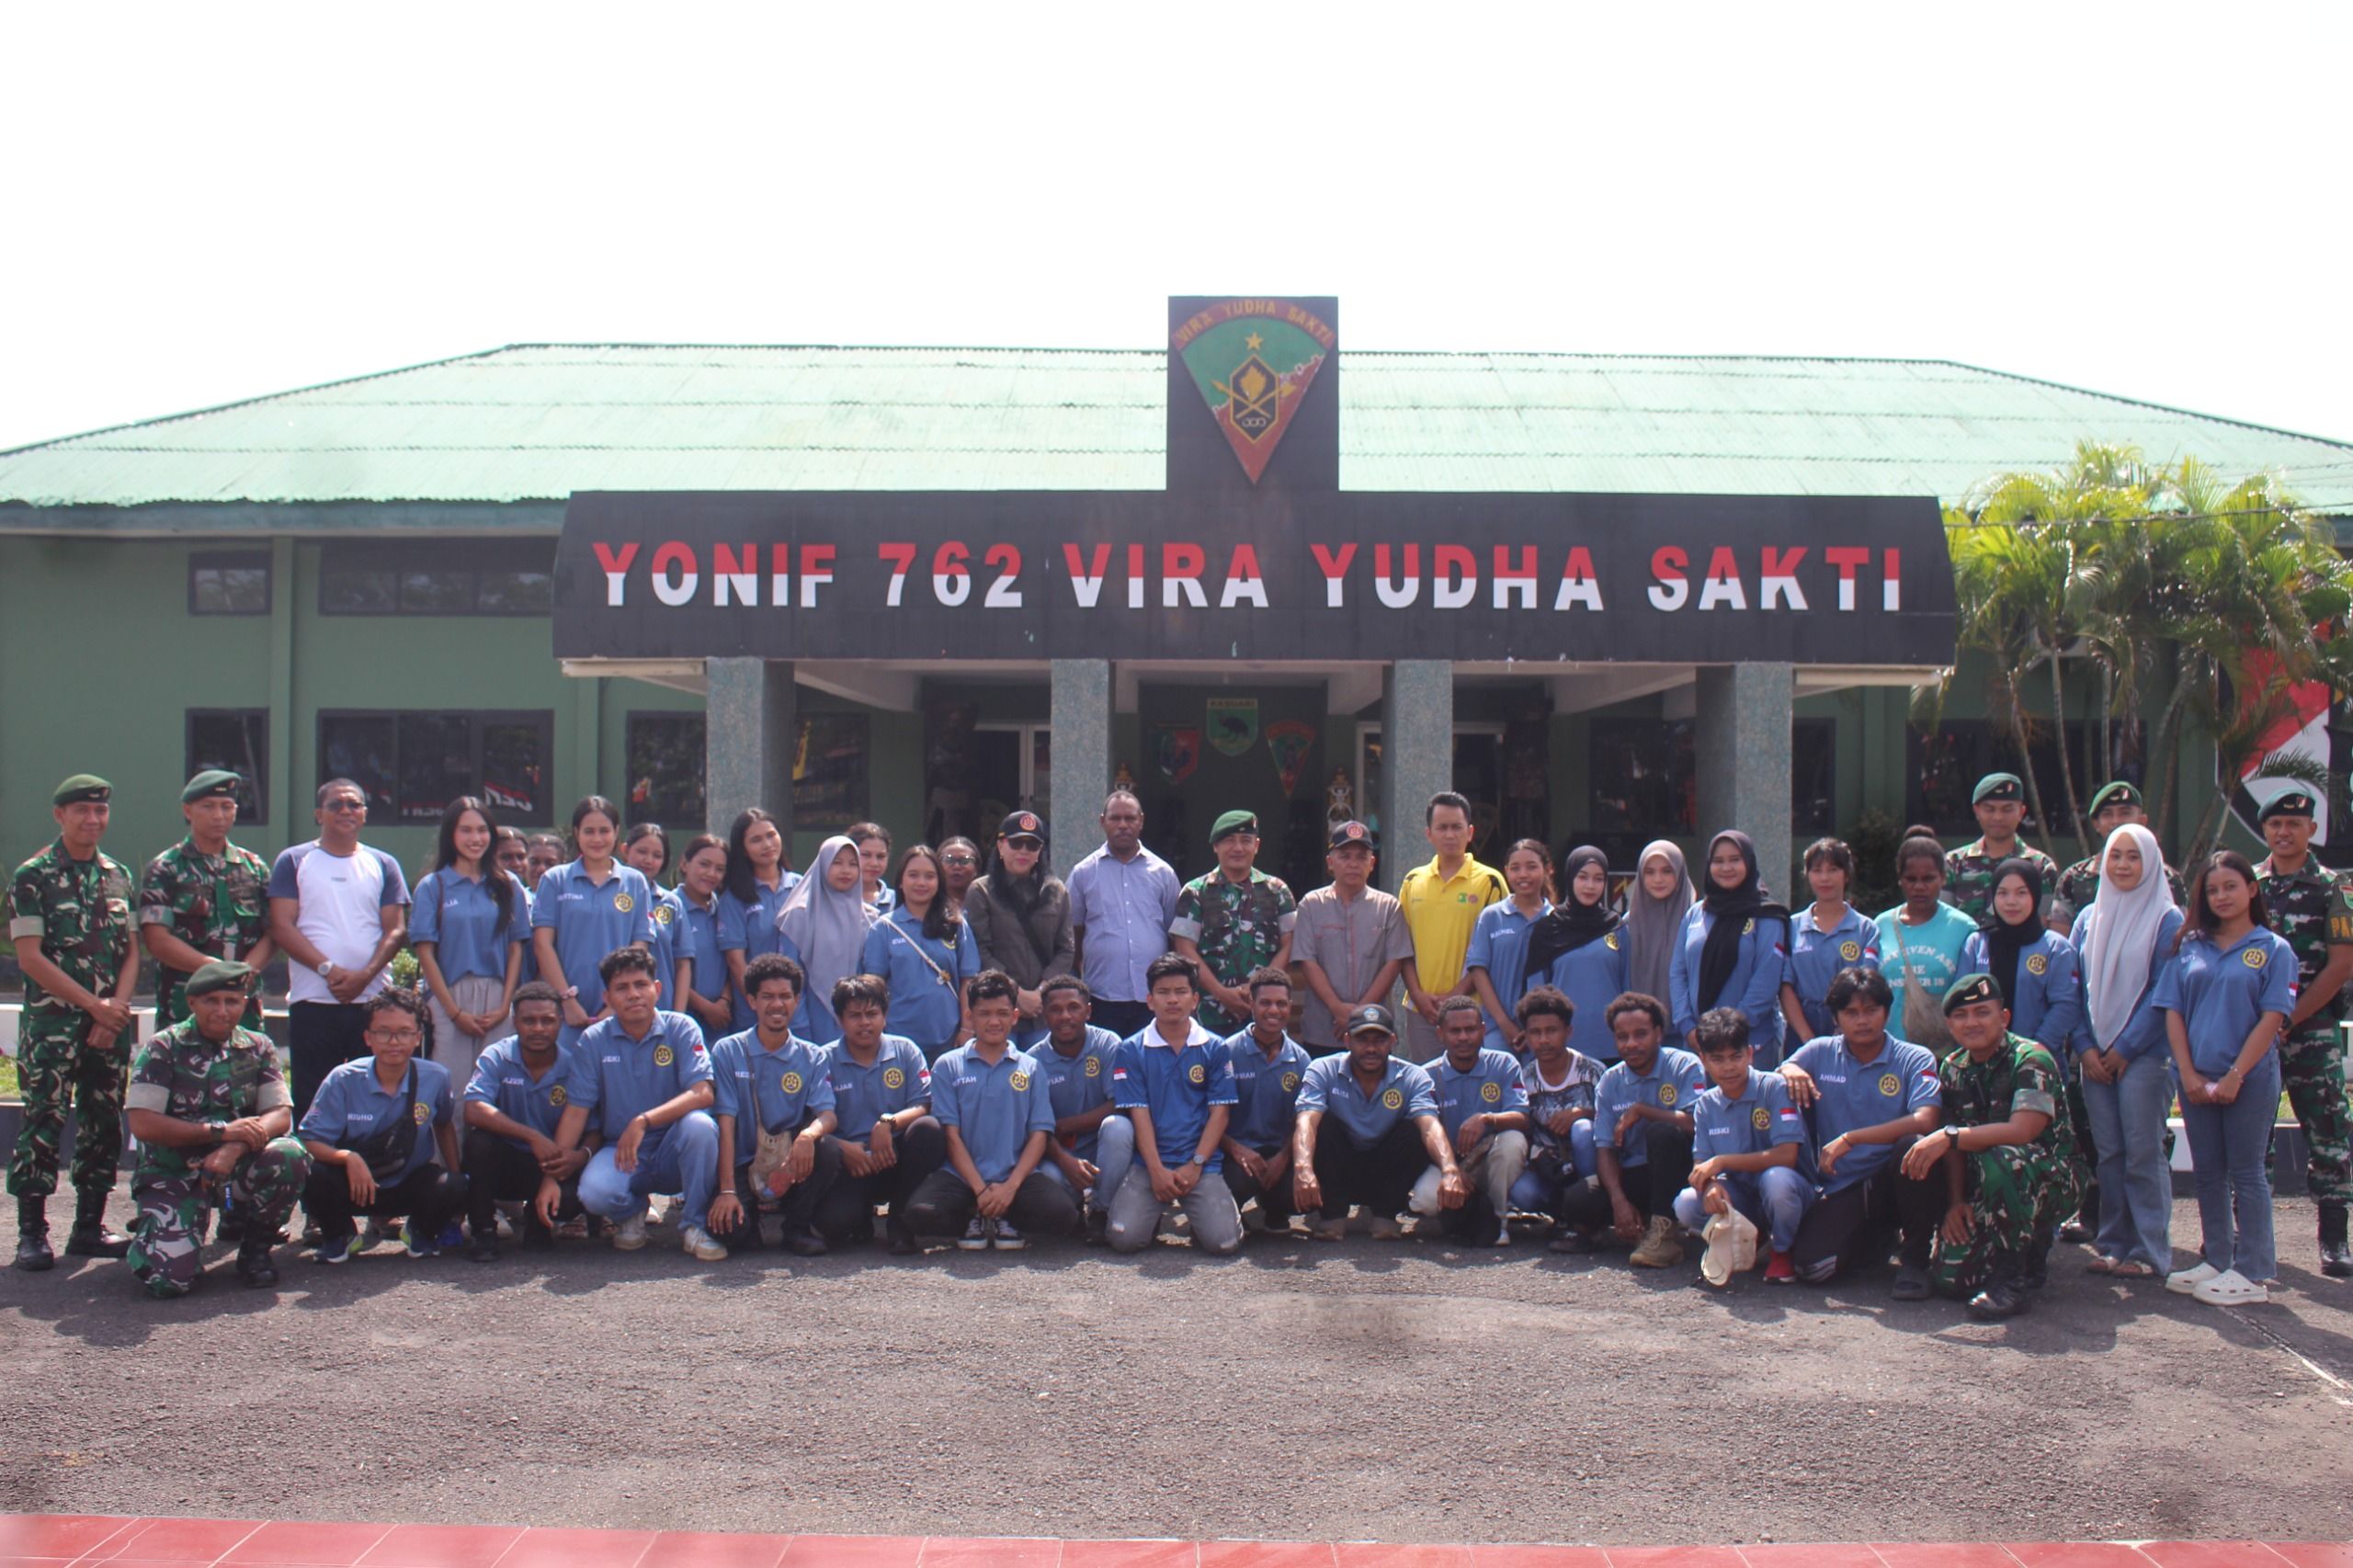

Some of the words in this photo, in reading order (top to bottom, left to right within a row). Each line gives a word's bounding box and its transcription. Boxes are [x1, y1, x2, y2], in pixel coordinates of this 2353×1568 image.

[1176, 312, 1214, 342] VIRA
[1223, 301, 1277, 317] YUDHA
[1288, 306, 1333, 344] SAKTI
[593, 541, 835, 608] YONIF
[879, 541, 1022, 608] 762
[1063, 542, 1268, 608] VIRA
[1311, 543, 1603, 610] YUDHA
[1647, 545, 1900, 611] SAKTI
[1899, 964, 1926, 975] TE
[1819, 1074, 1847, 1084] AHMAD
